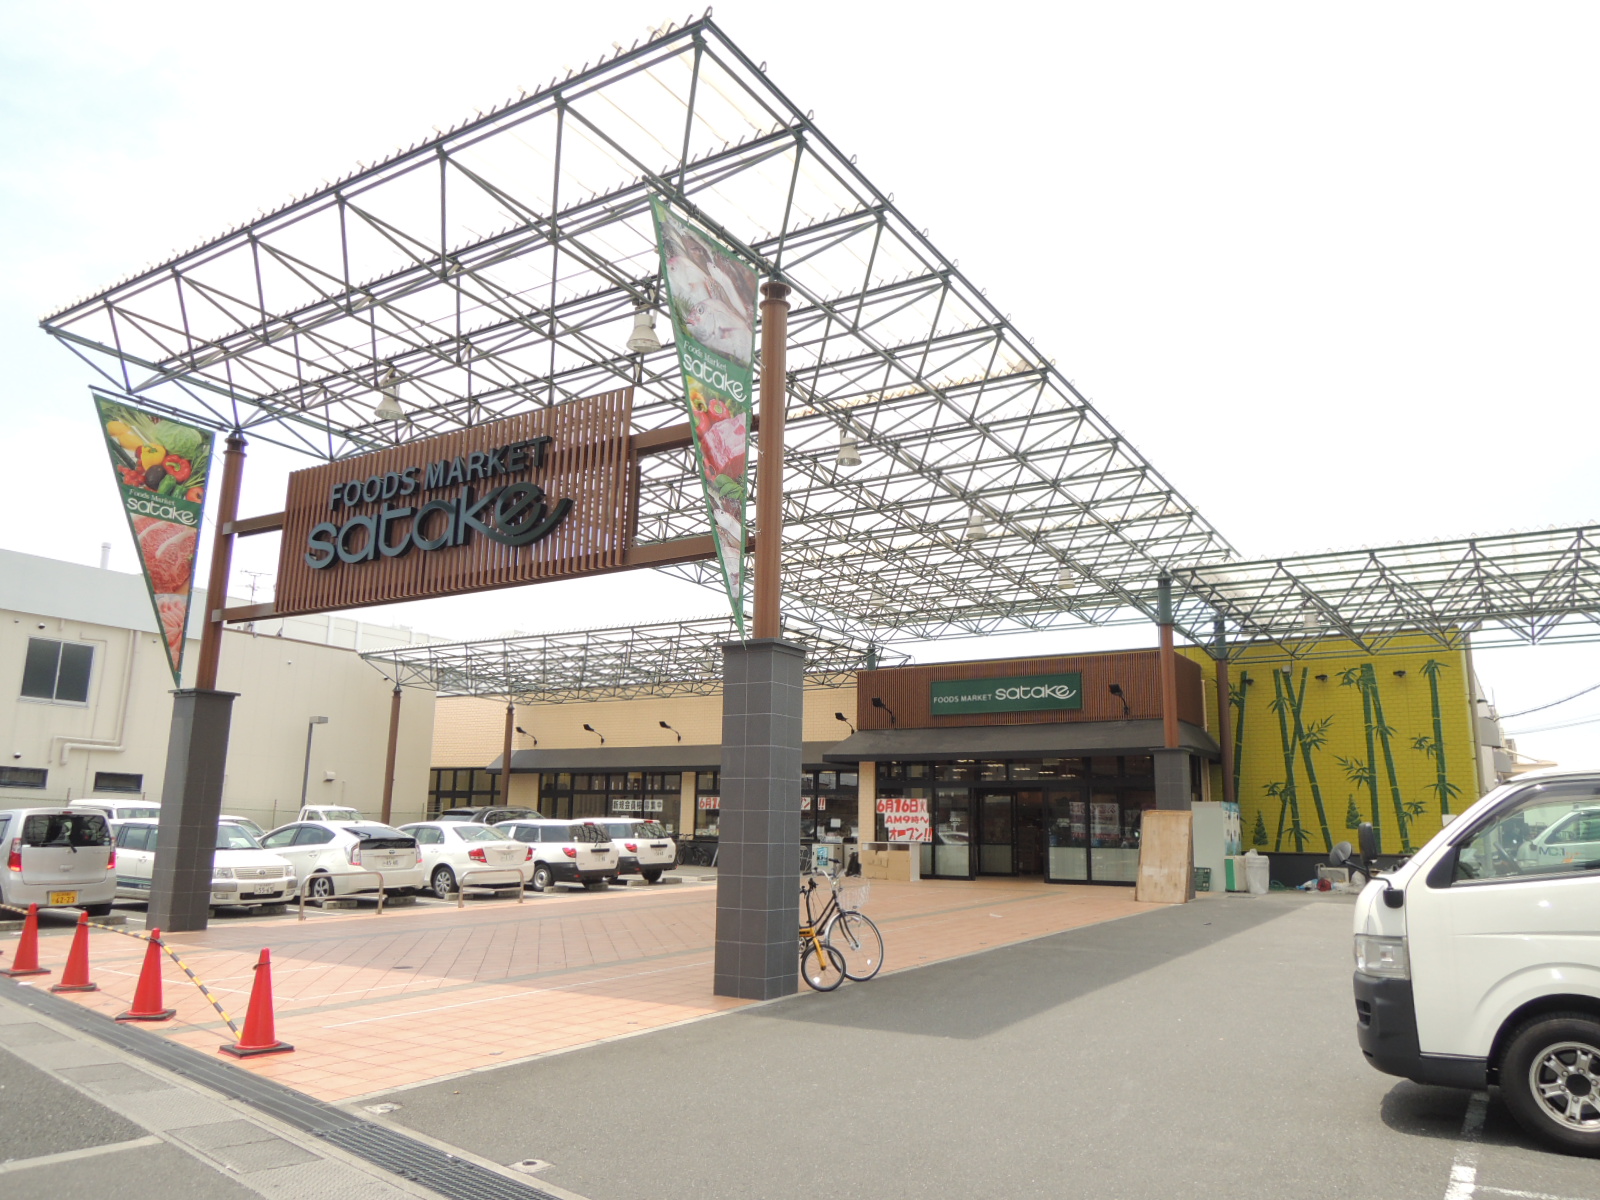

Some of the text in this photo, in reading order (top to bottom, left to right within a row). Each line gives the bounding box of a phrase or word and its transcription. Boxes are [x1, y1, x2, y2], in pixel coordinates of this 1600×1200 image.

[684, 340, 703, 358] Foods
[682, 353, 748, 402] satake
[330, 436, 552, 512] FOODS MARKET
[126, 497, 198, 525] satake
[128, 488, 176, 506] Foods Market
[305, 481, 574, 570] satake
[933, 684, 1077, 703] FOODS MARKET satake
